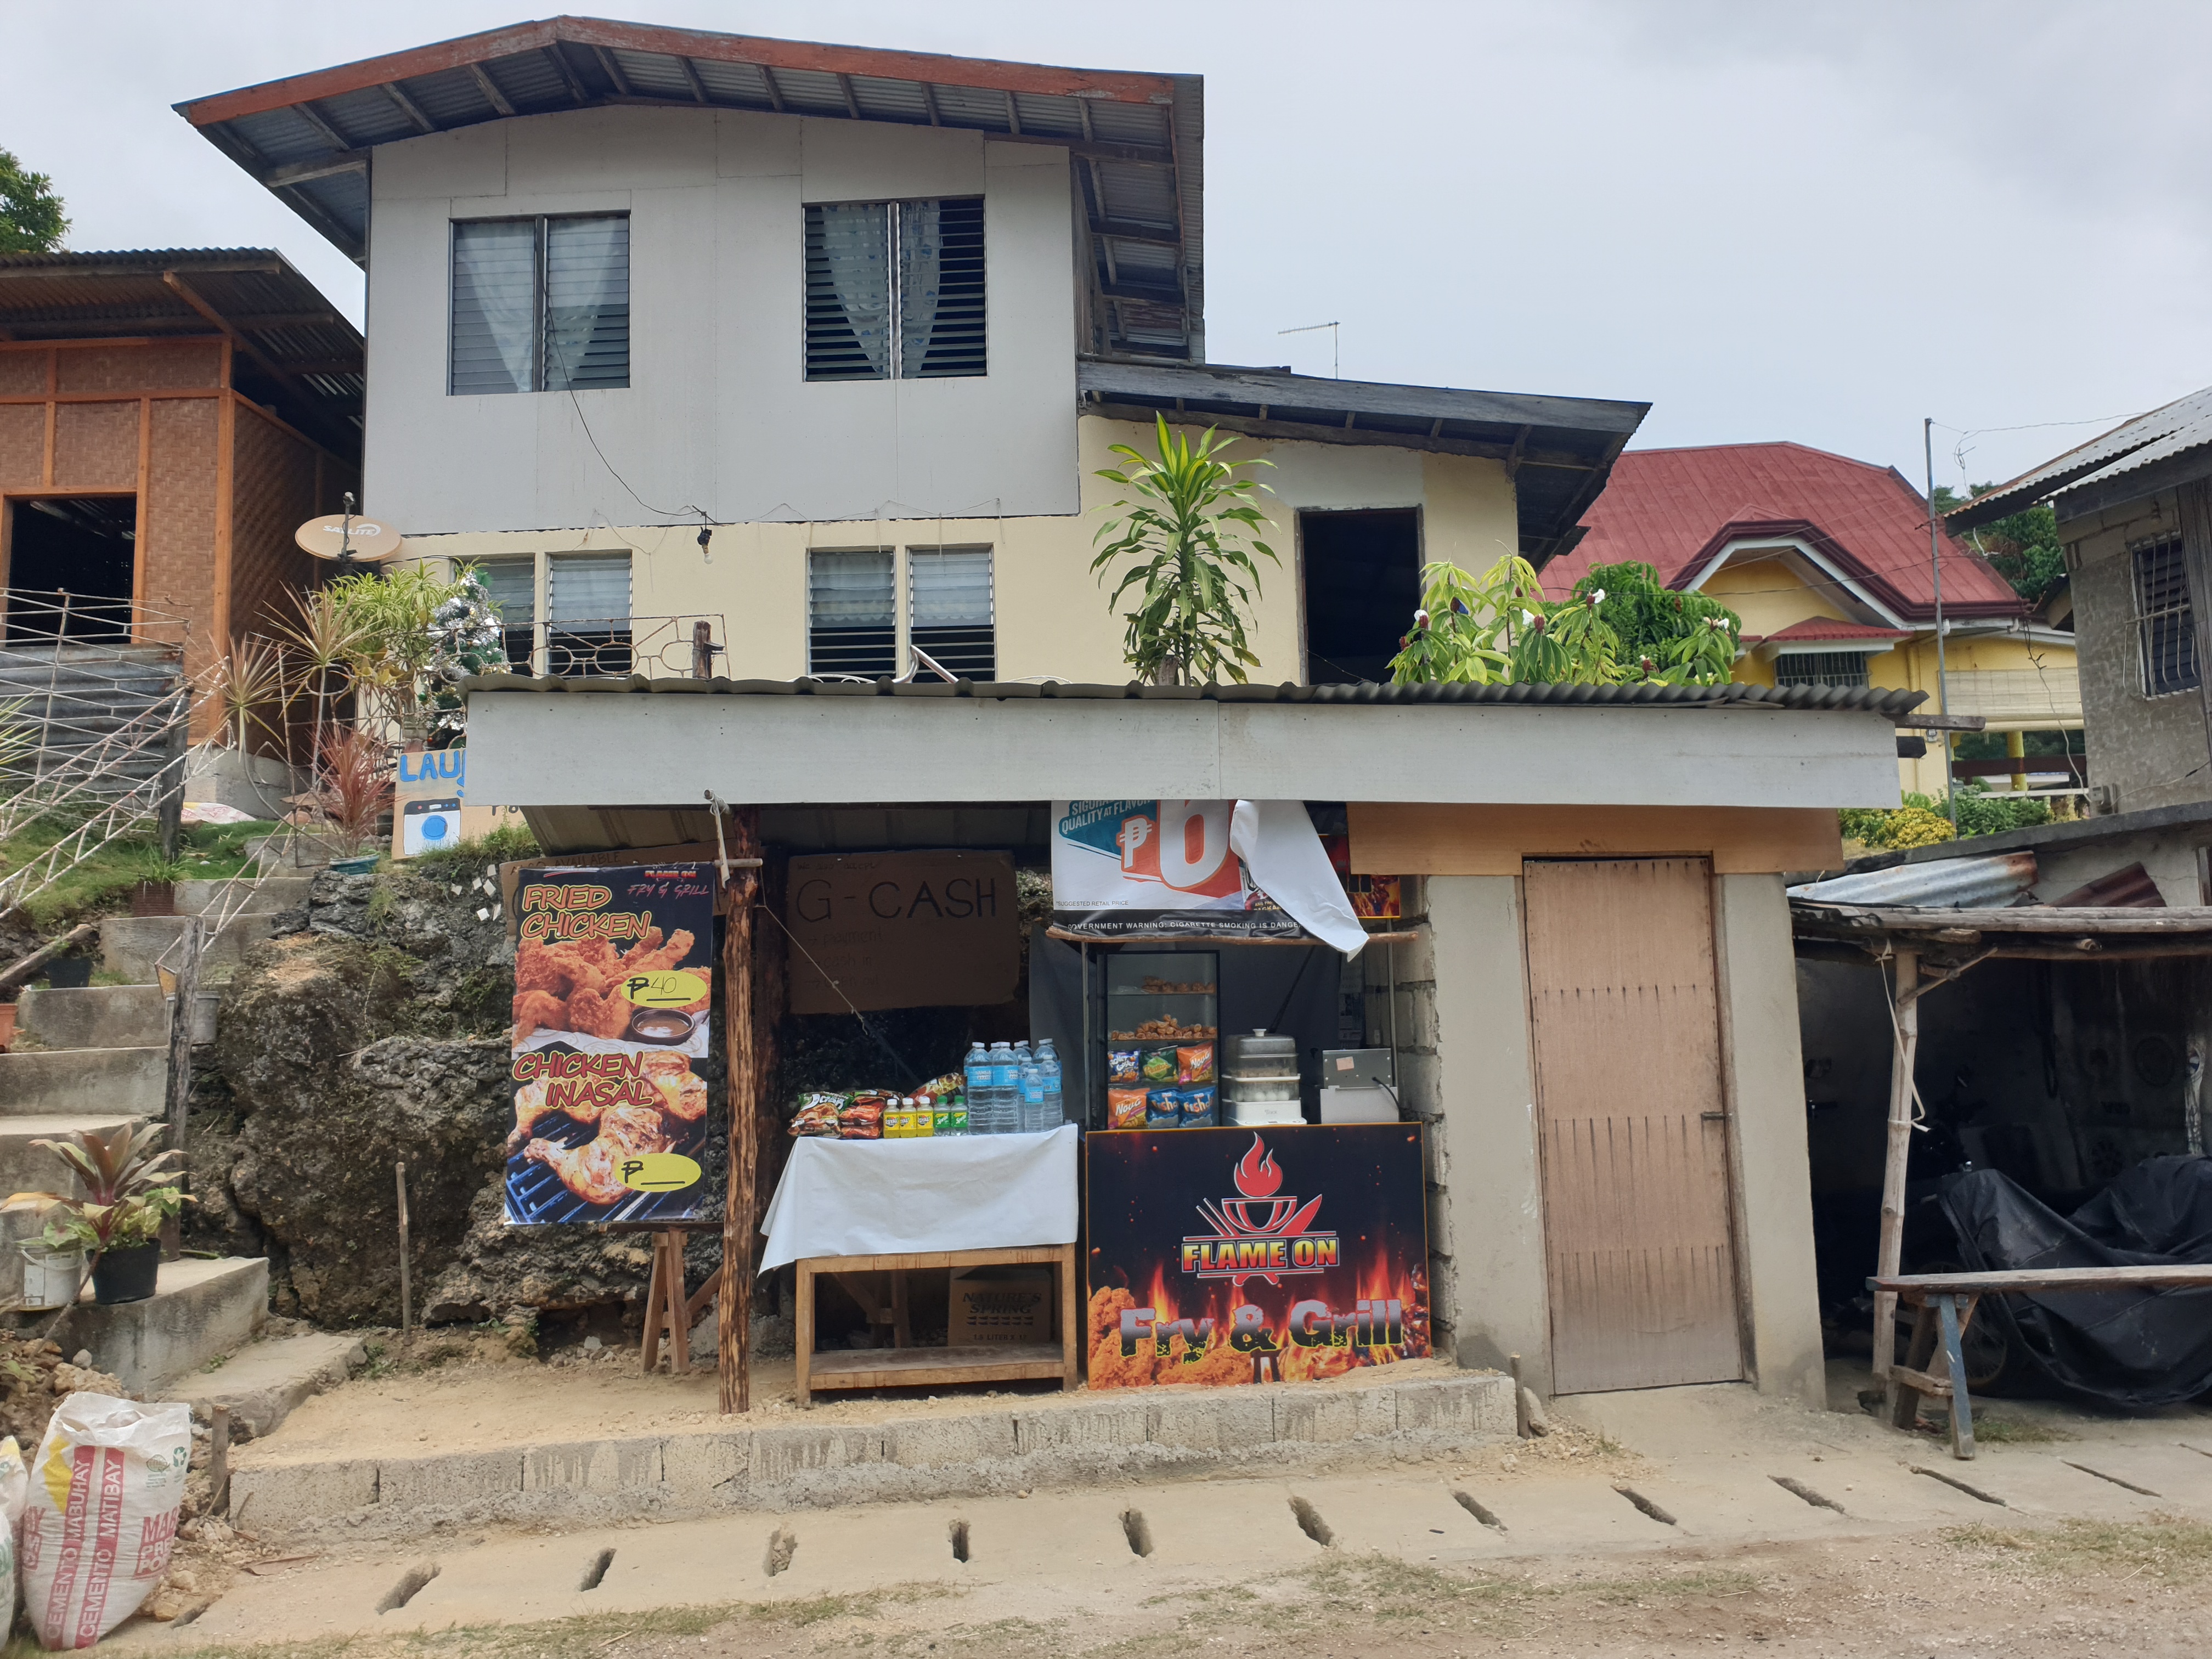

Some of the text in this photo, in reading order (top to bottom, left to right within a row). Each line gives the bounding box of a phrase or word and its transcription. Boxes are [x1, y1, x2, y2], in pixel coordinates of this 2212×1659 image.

[400, 751, 466, 782] LAU
[1062, 808, 1103, 834] QUALITY
[1104, 806, 1112, 817] AT
[523, 885, 612, 911] FRIED
[628, 884, 655, 897] FRY
[674, 884, 709, 900] GRILL
[521, 911, 651, 939] CHICKEN
[512, 1049, 644, 1081] CHICKEN
[544, 1080, 653, 1109] INASAL
[1183, 1238, 1339, 1272] FLAME ON
[1120, 1299, 1403, 1364] Fry & Grill
[47, 1460, 90, 1639] CEMENTO MABUHAY
[80, 1459, 122, 1637] CEMENTO MATIBAY
